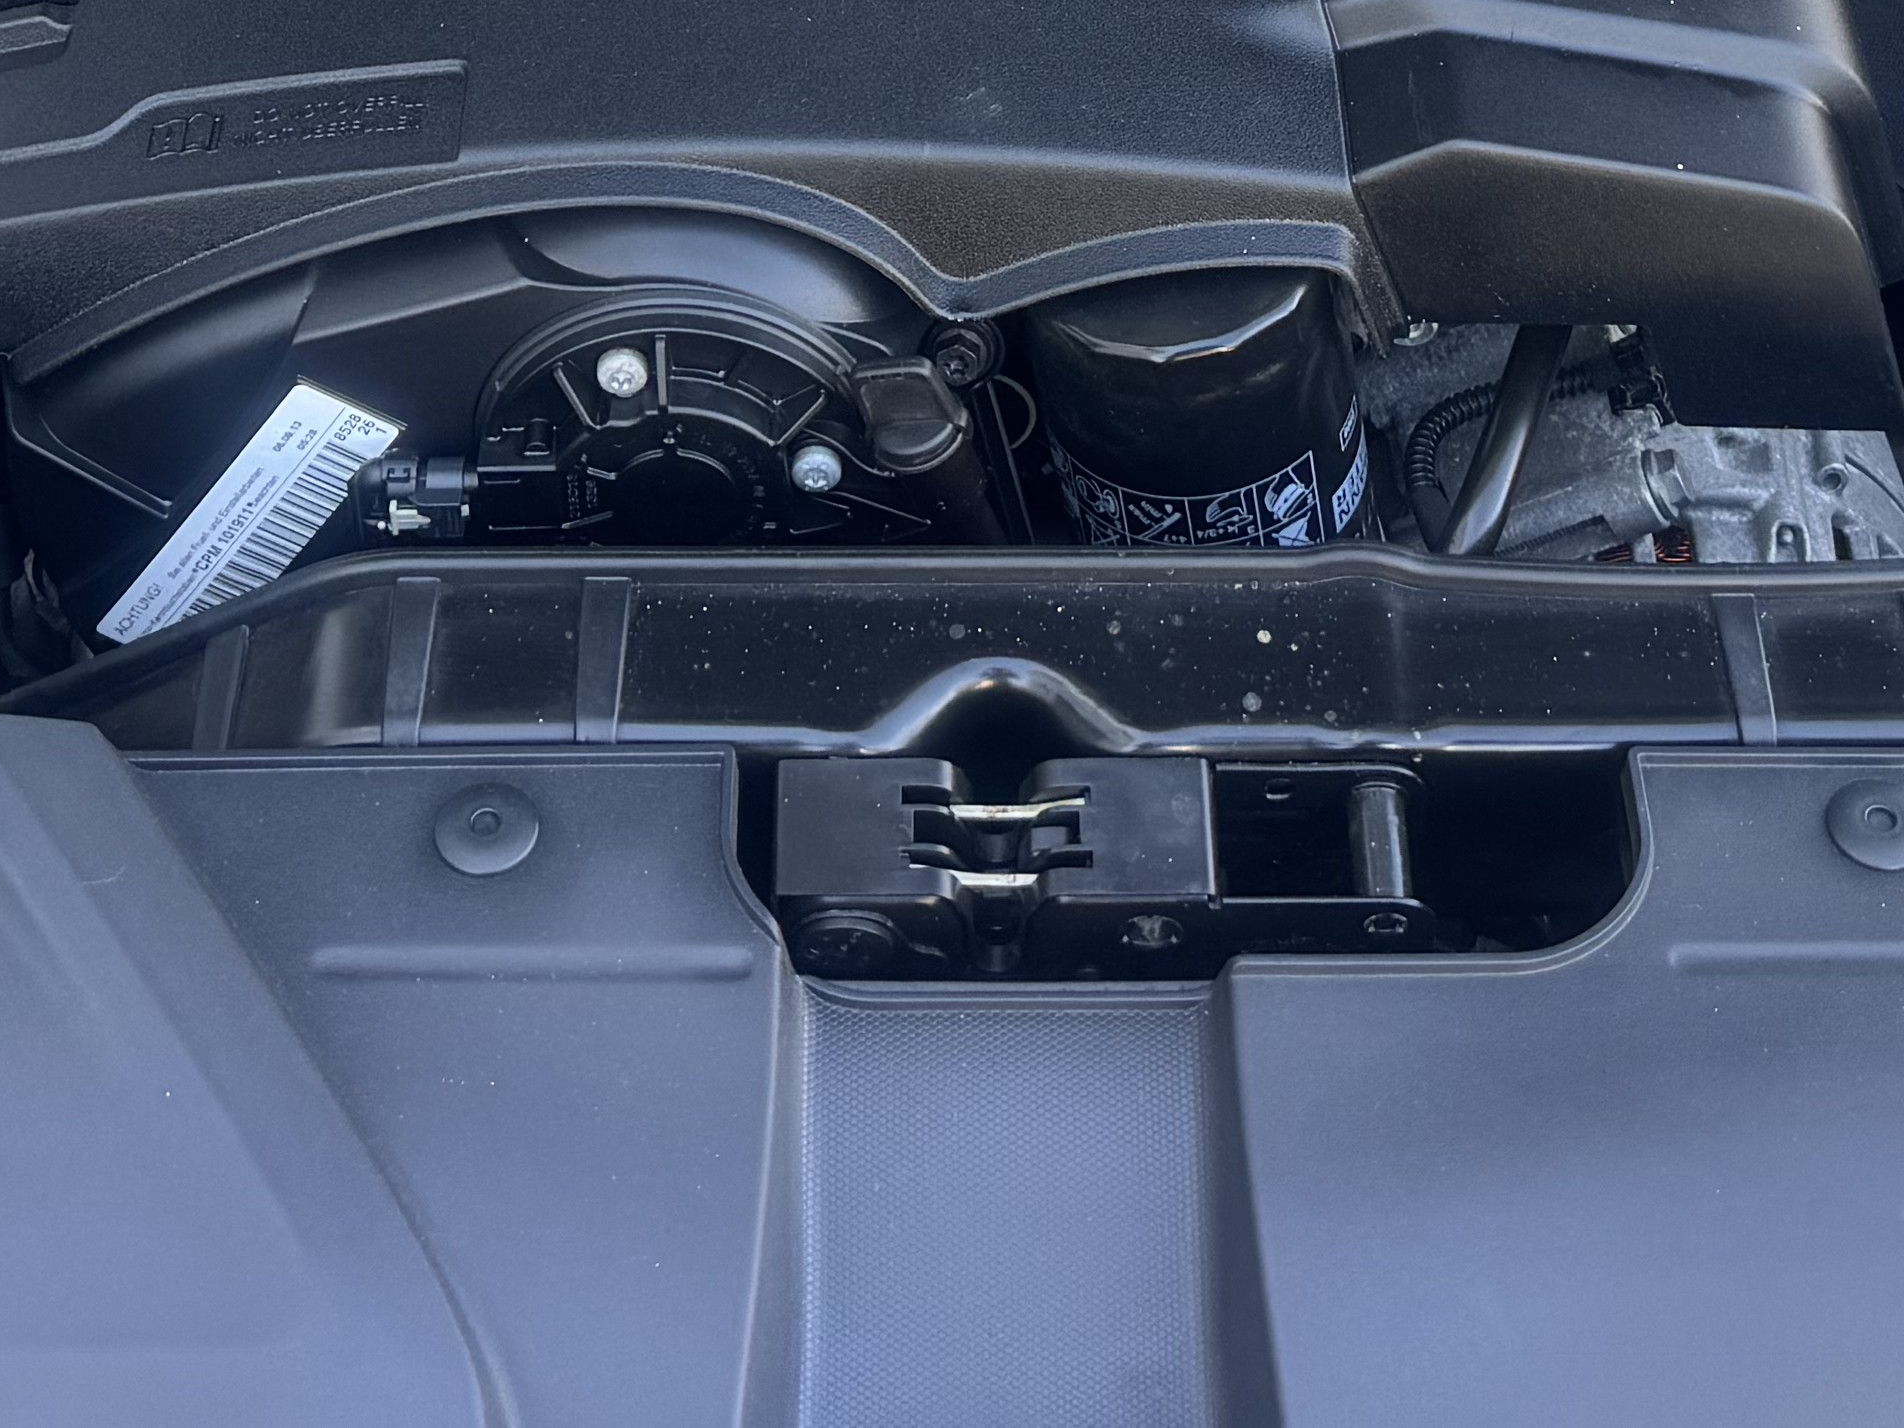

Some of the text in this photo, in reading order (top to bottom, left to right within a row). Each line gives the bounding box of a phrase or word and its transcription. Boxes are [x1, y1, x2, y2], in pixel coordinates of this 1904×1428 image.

[334, 413, 362, 442] 8528
[358, 420, 376, 436] 26
[375, 426, 388, 435] 1
[116, 584, 162, 635] ACHTUNG!
